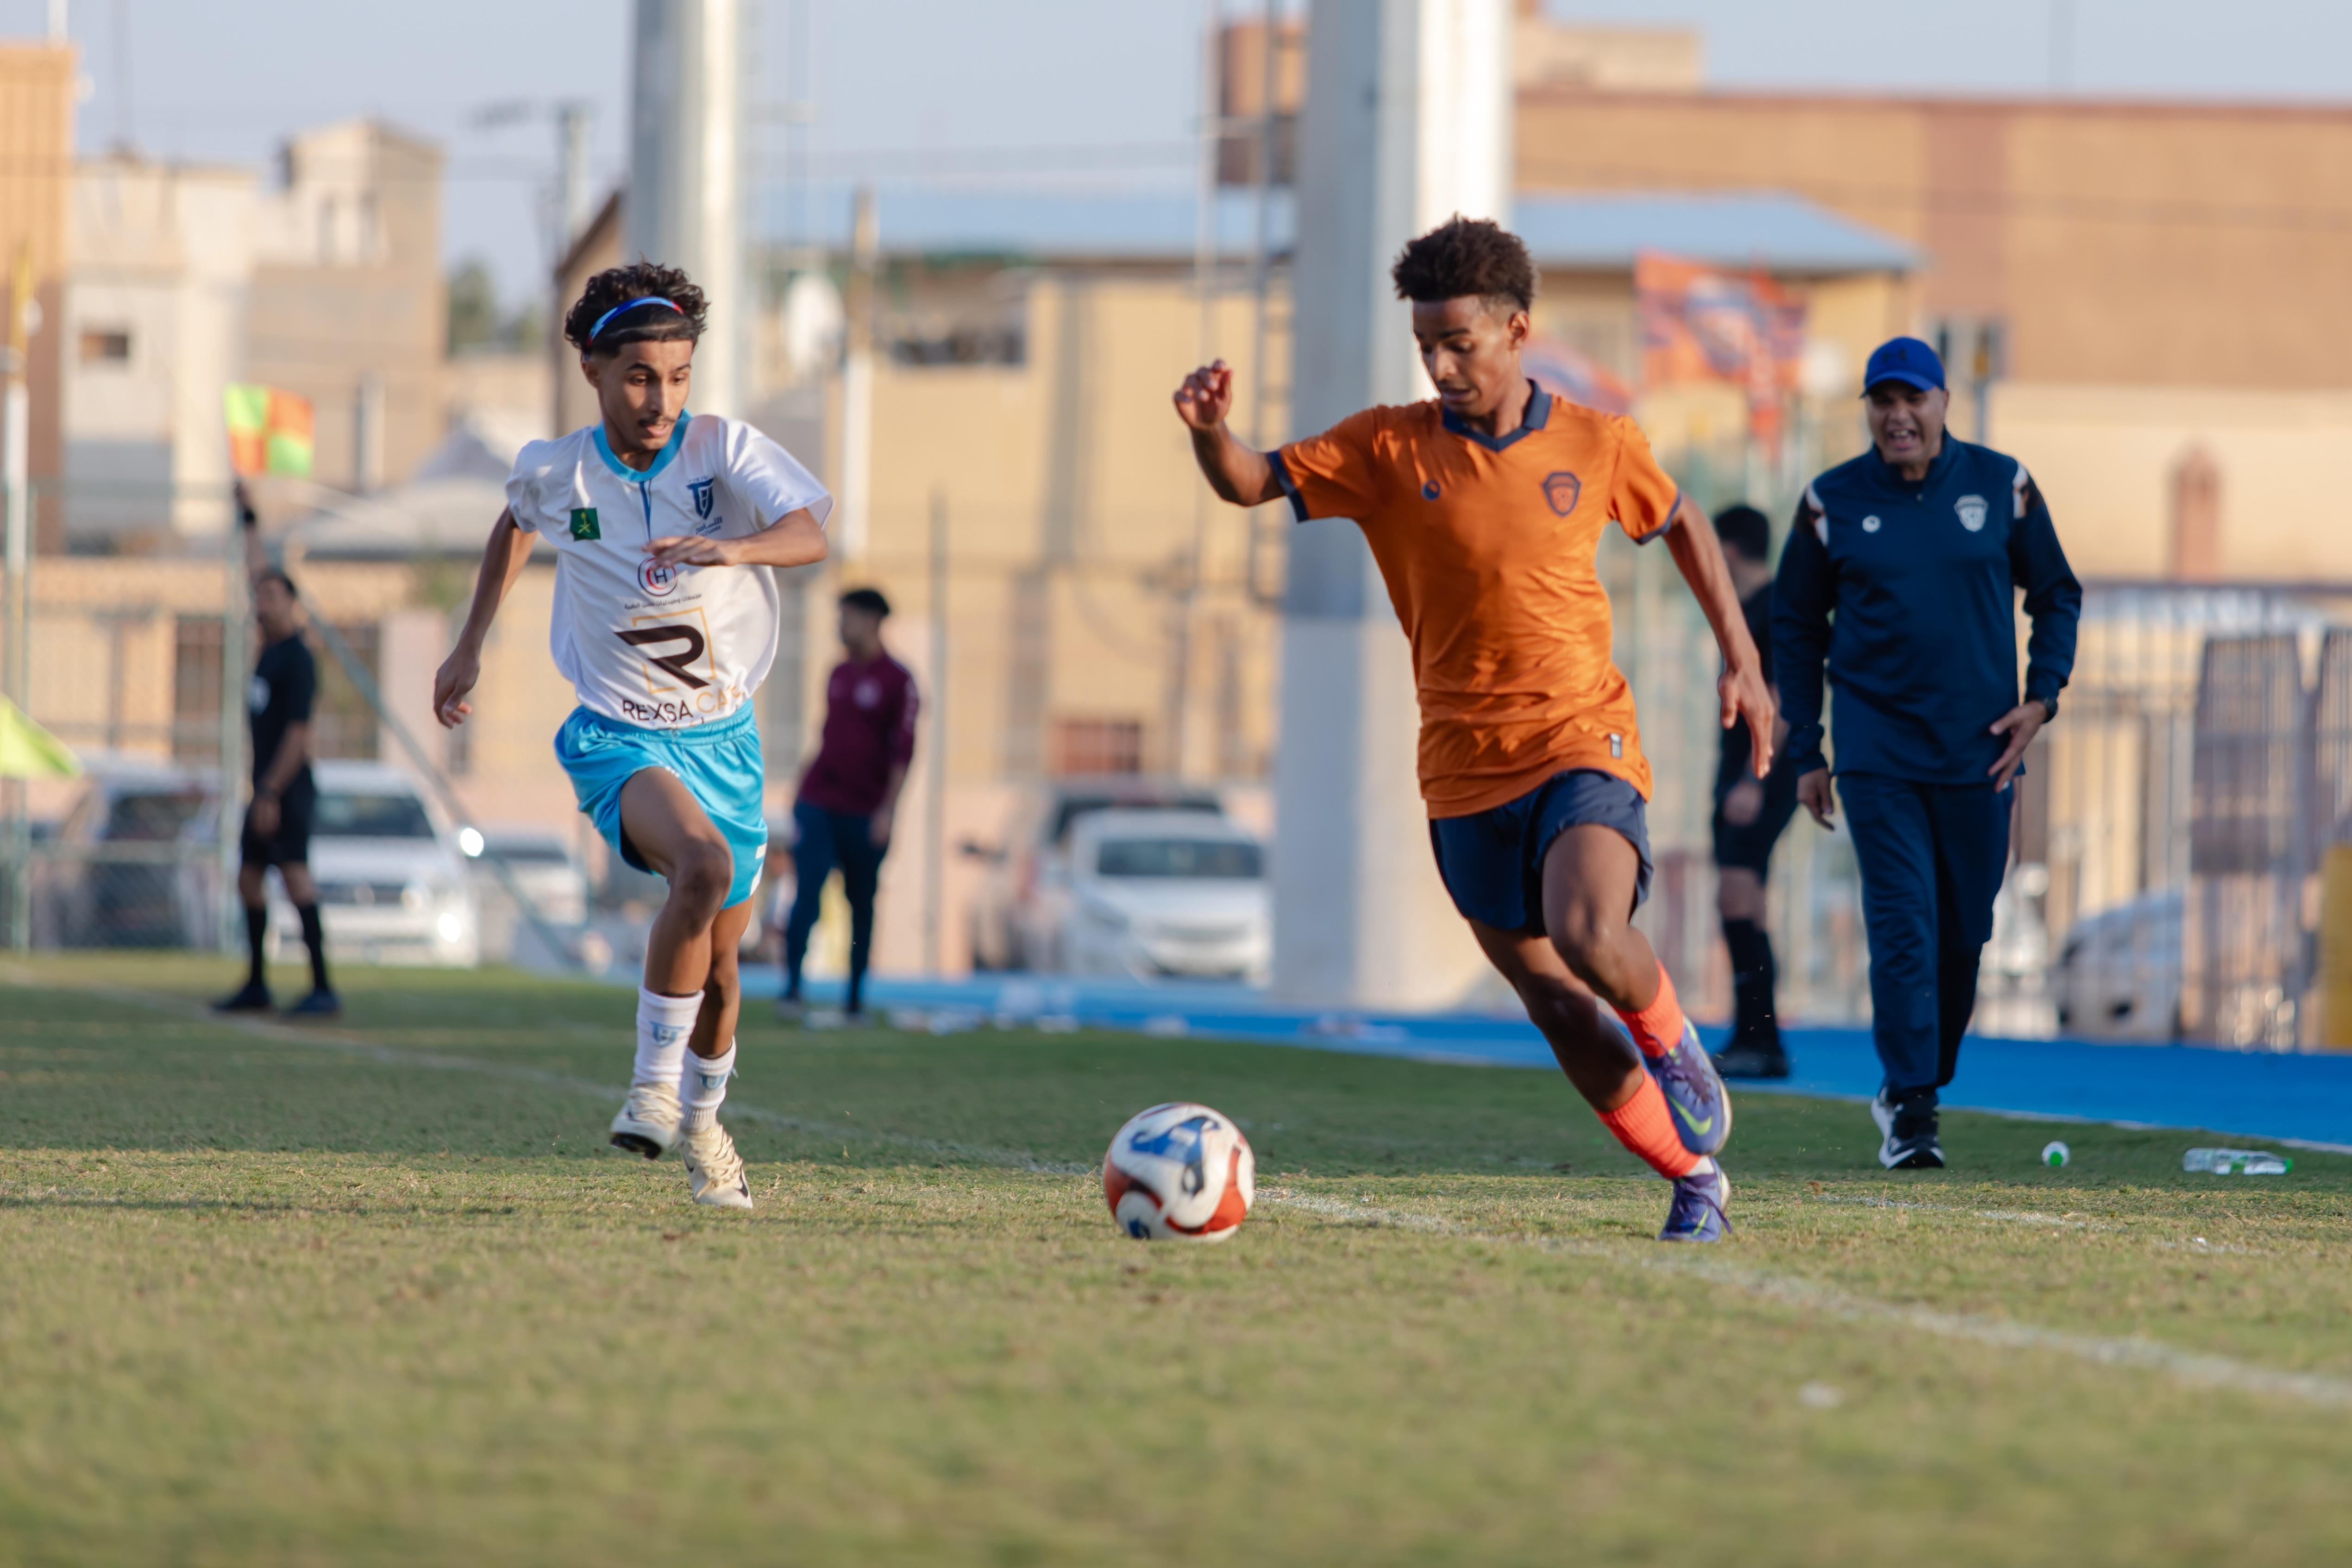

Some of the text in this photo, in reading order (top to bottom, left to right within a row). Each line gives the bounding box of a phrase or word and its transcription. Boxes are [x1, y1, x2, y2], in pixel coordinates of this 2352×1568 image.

[653, 567, 668, 584] H
[622, 685, 743, 722] REXSA CA
